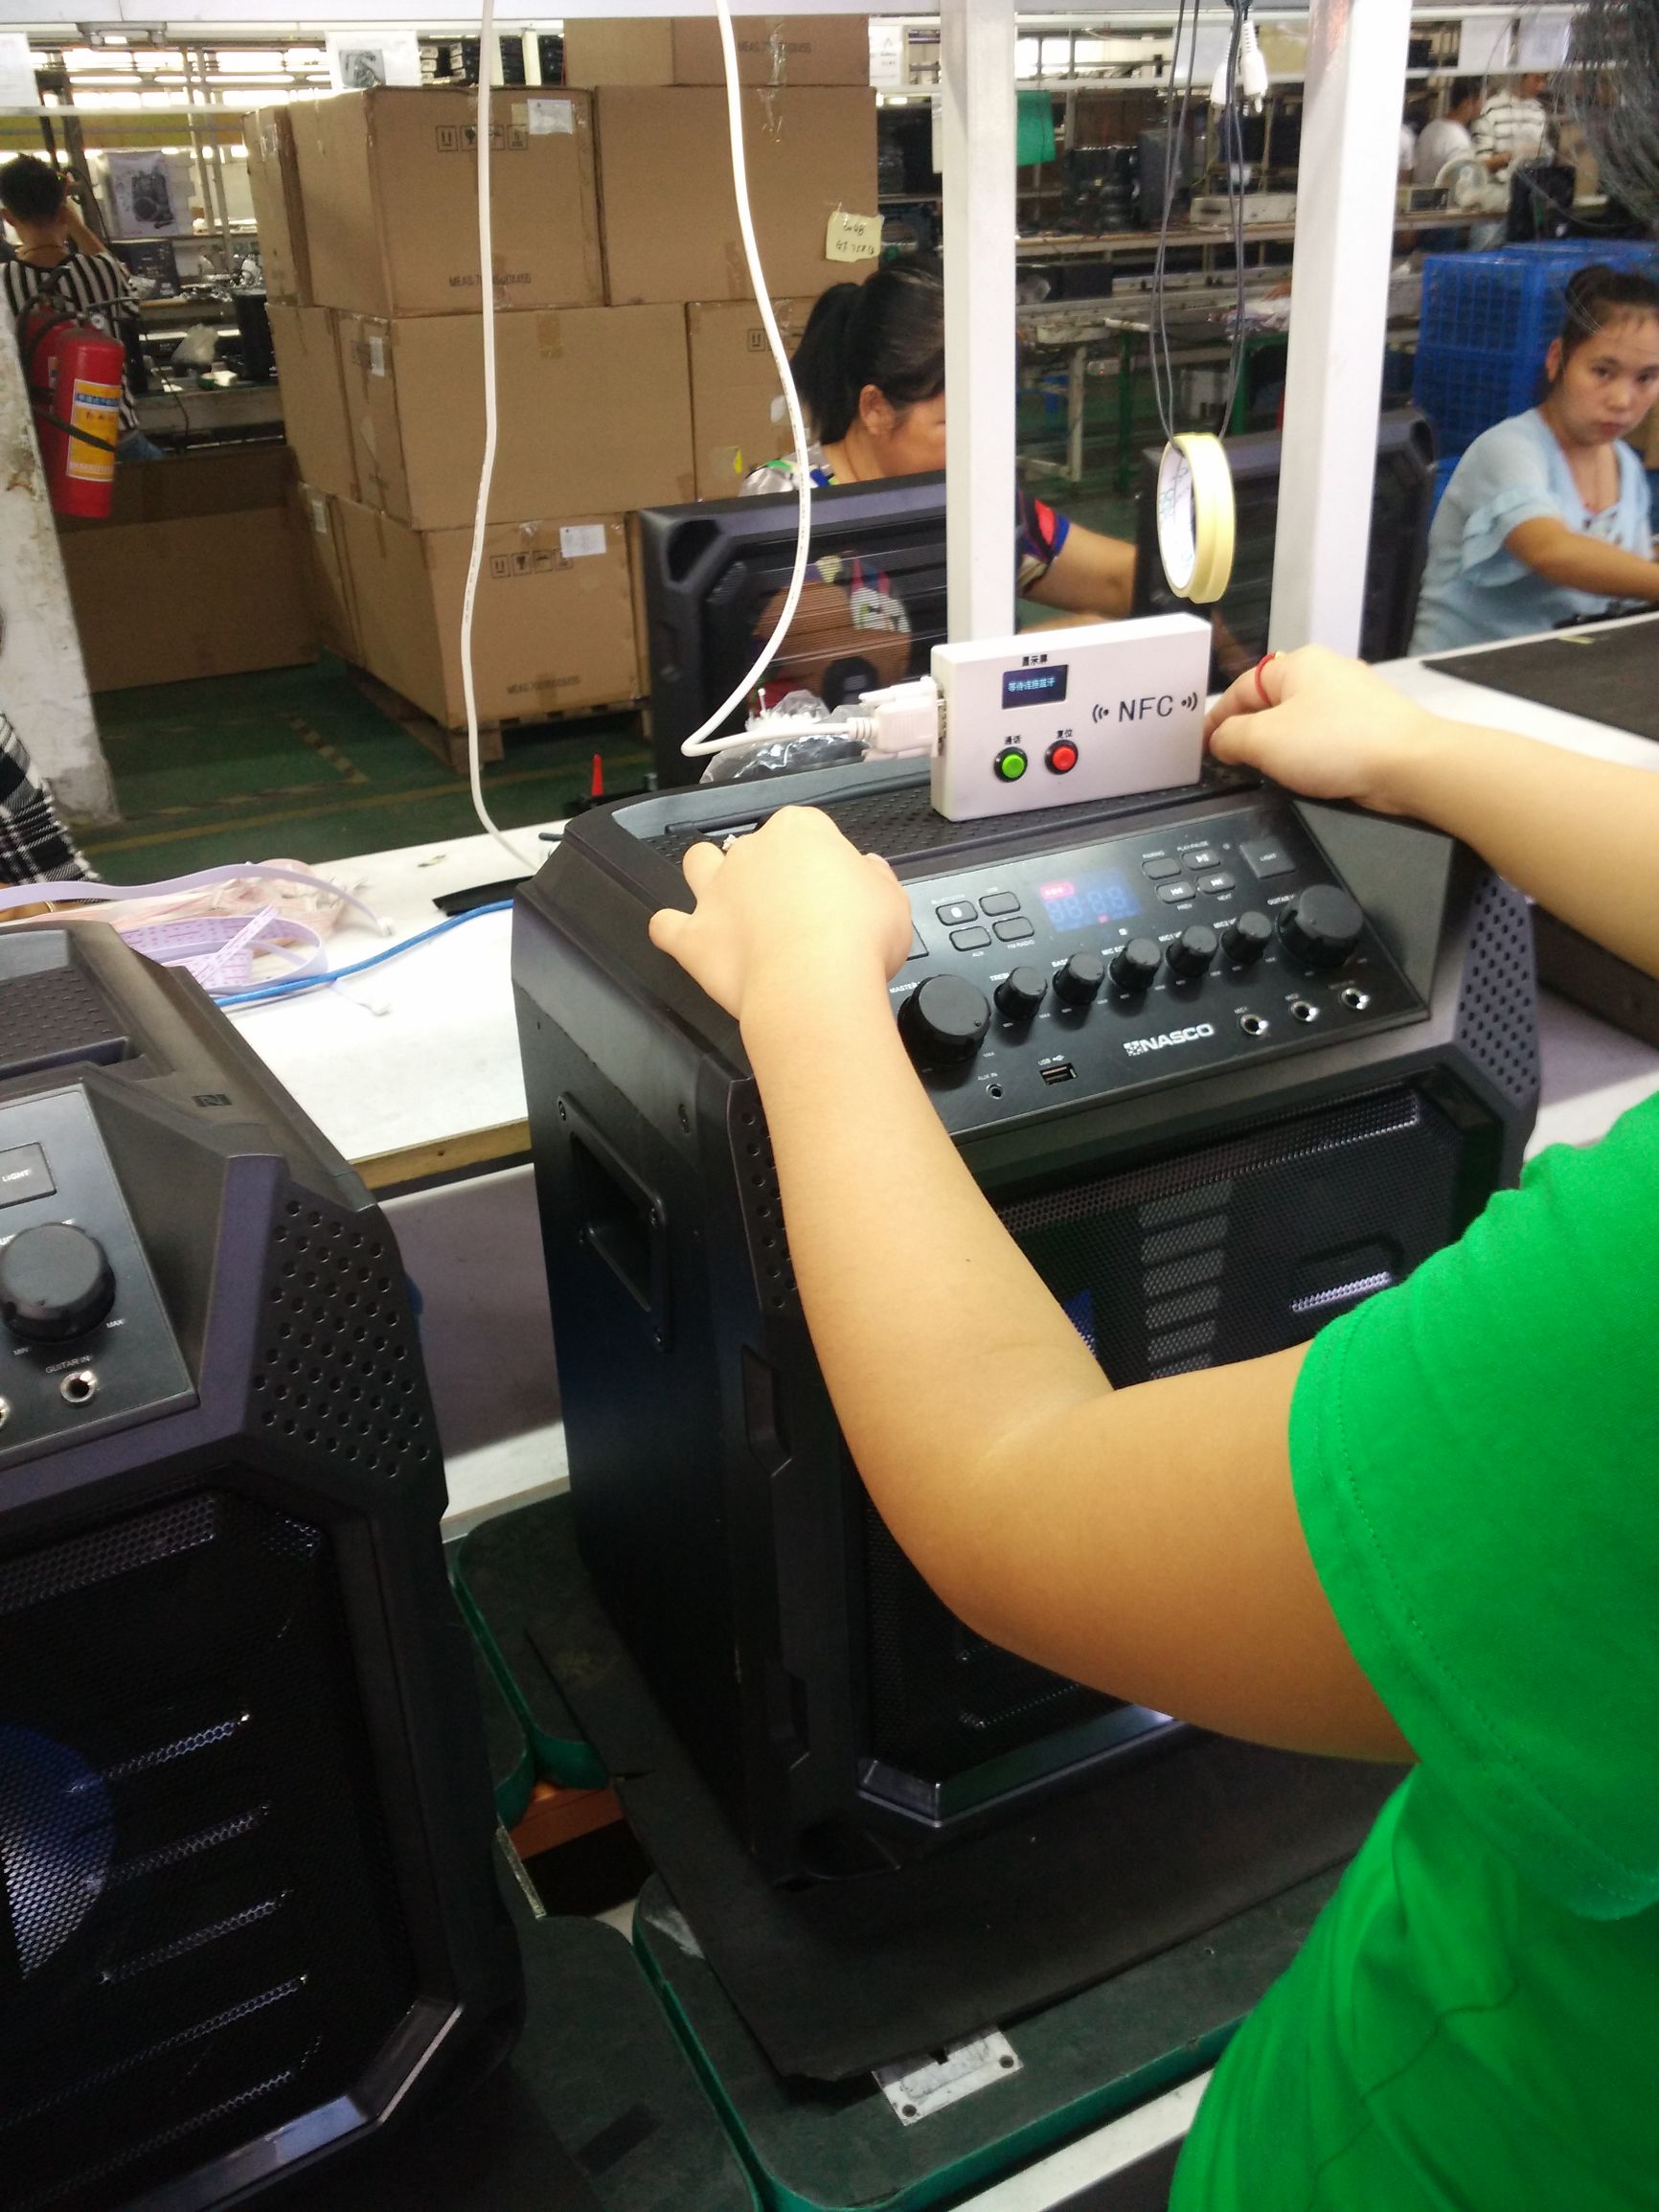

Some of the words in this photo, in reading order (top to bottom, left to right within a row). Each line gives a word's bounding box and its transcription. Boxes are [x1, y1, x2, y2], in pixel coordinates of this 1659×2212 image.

[1118, 695, 1173, 722] NFC
[1138, 1022, 1216, 1053] NASCO
[2, 1169, 31, 1182] LIGHT
[45, 1358, 80, 1374] GUITAR
